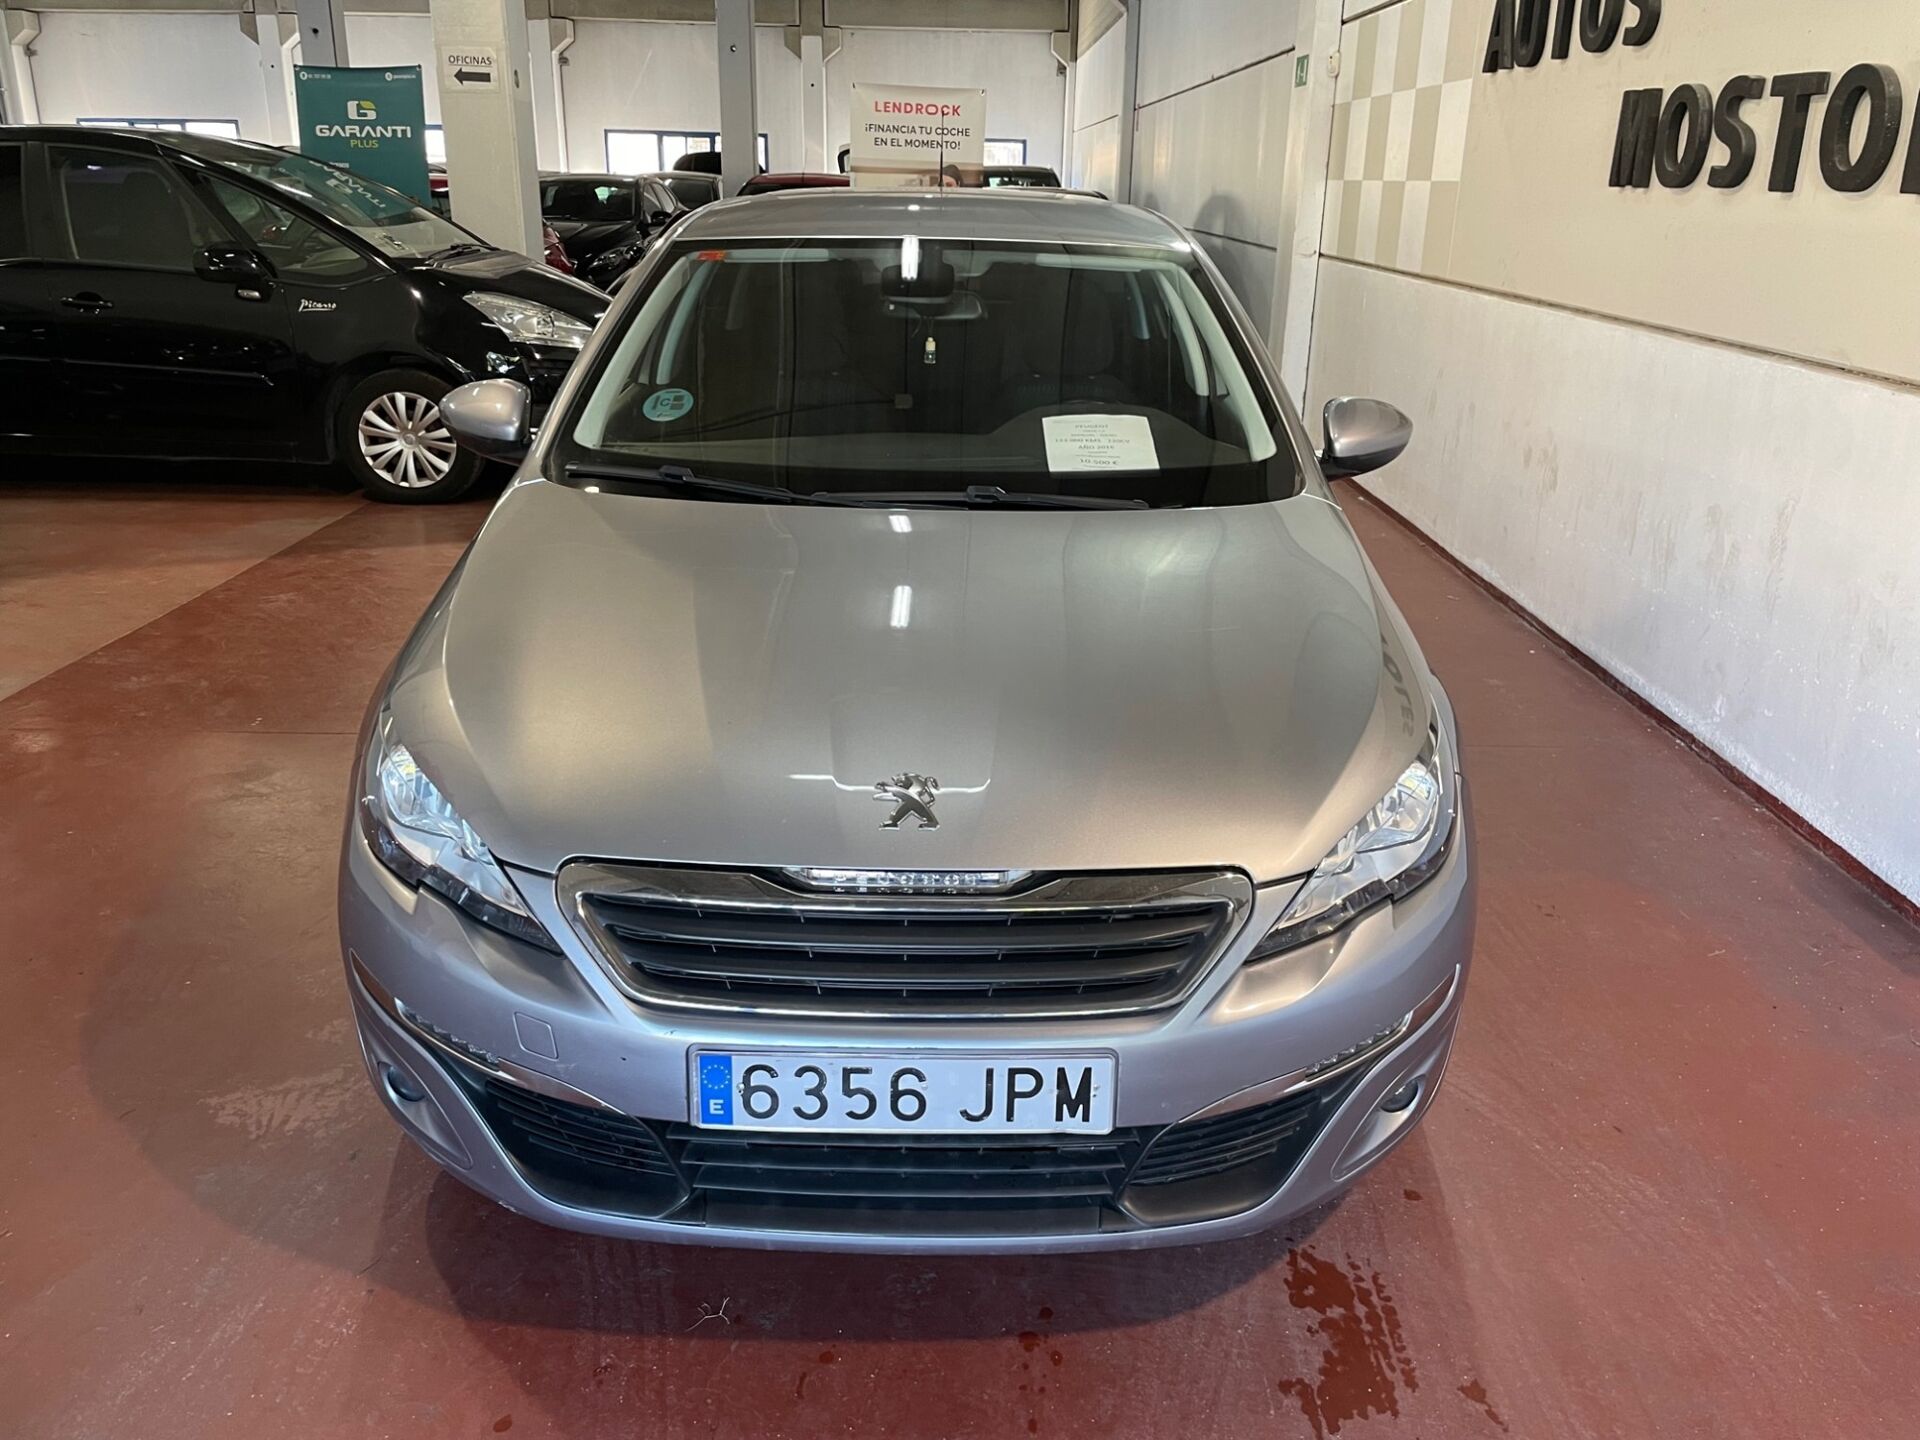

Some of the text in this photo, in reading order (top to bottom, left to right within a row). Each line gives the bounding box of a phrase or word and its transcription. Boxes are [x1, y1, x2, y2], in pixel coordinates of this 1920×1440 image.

[1482, 0, 1662, 73] AUTOS
[448, 55, 492, 65] OFICINAS
[874, 101, 961, 116] LENDROCK
[315, 125, 412, 138] GARANTI
[864, 123, 971, 137] ¡FINANCIA TU COCHE
[350, 140, 379, 148] PLUS
[874, 137, 961, 150] EN EL MOMENTO!
[741, 1063, 1093, 1123] 6356 JPM
[709, 1099, 724, 1115] E
